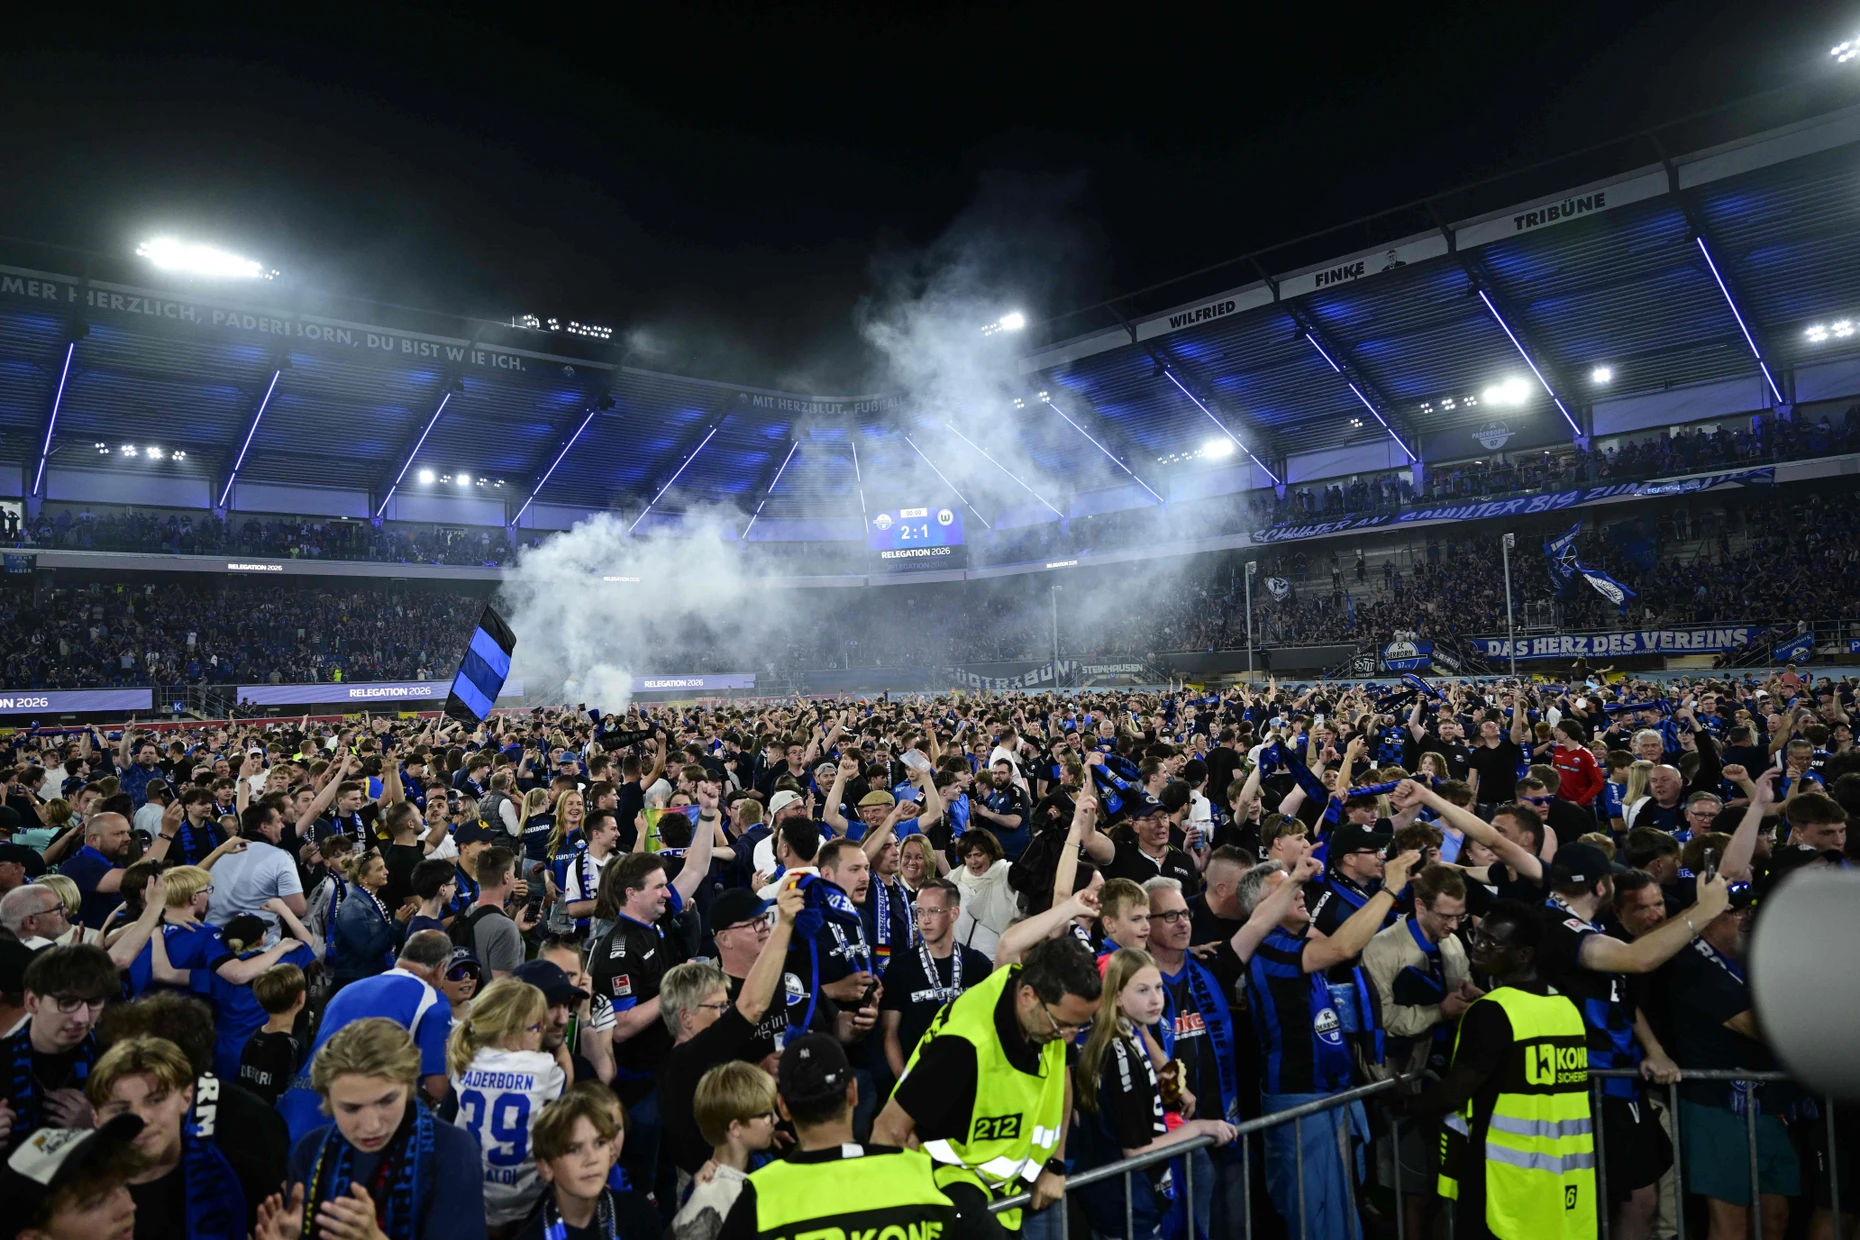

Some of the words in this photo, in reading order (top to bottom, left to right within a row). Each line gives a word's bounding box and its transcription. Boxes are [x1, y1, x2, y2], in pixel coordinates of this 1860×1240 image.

[1513, 192, 1606, 231] TRIBÜNE
[1315, 261, 1365, 287] FINKE
[1169, 301, 1236, 329] WILFRIED
[367, 333, 394, 351] DU
[401, 338, 439, 359] BIST
[446, 346, 486, 366] WIE
[491, 353, 527, 371] ICH.
[753, 395, 774, 408] MIT
[1523, 490, 1578, 514] BIS
[881, 548, 930, 559] RELEGATION
[931, 547, 951, 556] 2026
[228, 563, 267, 571] RELEGATION
[1487, 640, 1529, 657] DAS
[1533, 636, 1589, 655] HERZ
[1592, 633, 1637, 652] DES
[1641, 628, 1750, 651] VEREINS
[1082, 663, 1145, 675] STEINHAUSEN
[350, 688, 408, 698] RELEGATION
[409, 687, 431, 696] 2026
[644, 680, 686, 689] RELEGATION
[16, 697, 49, 708] 2026
[173, 703, 182, 711] K
[461, 1089, 531, 1166] 39
[975, 1116, 1018, 1139] 212
[1565, 1187, 1577, 1207] 6
